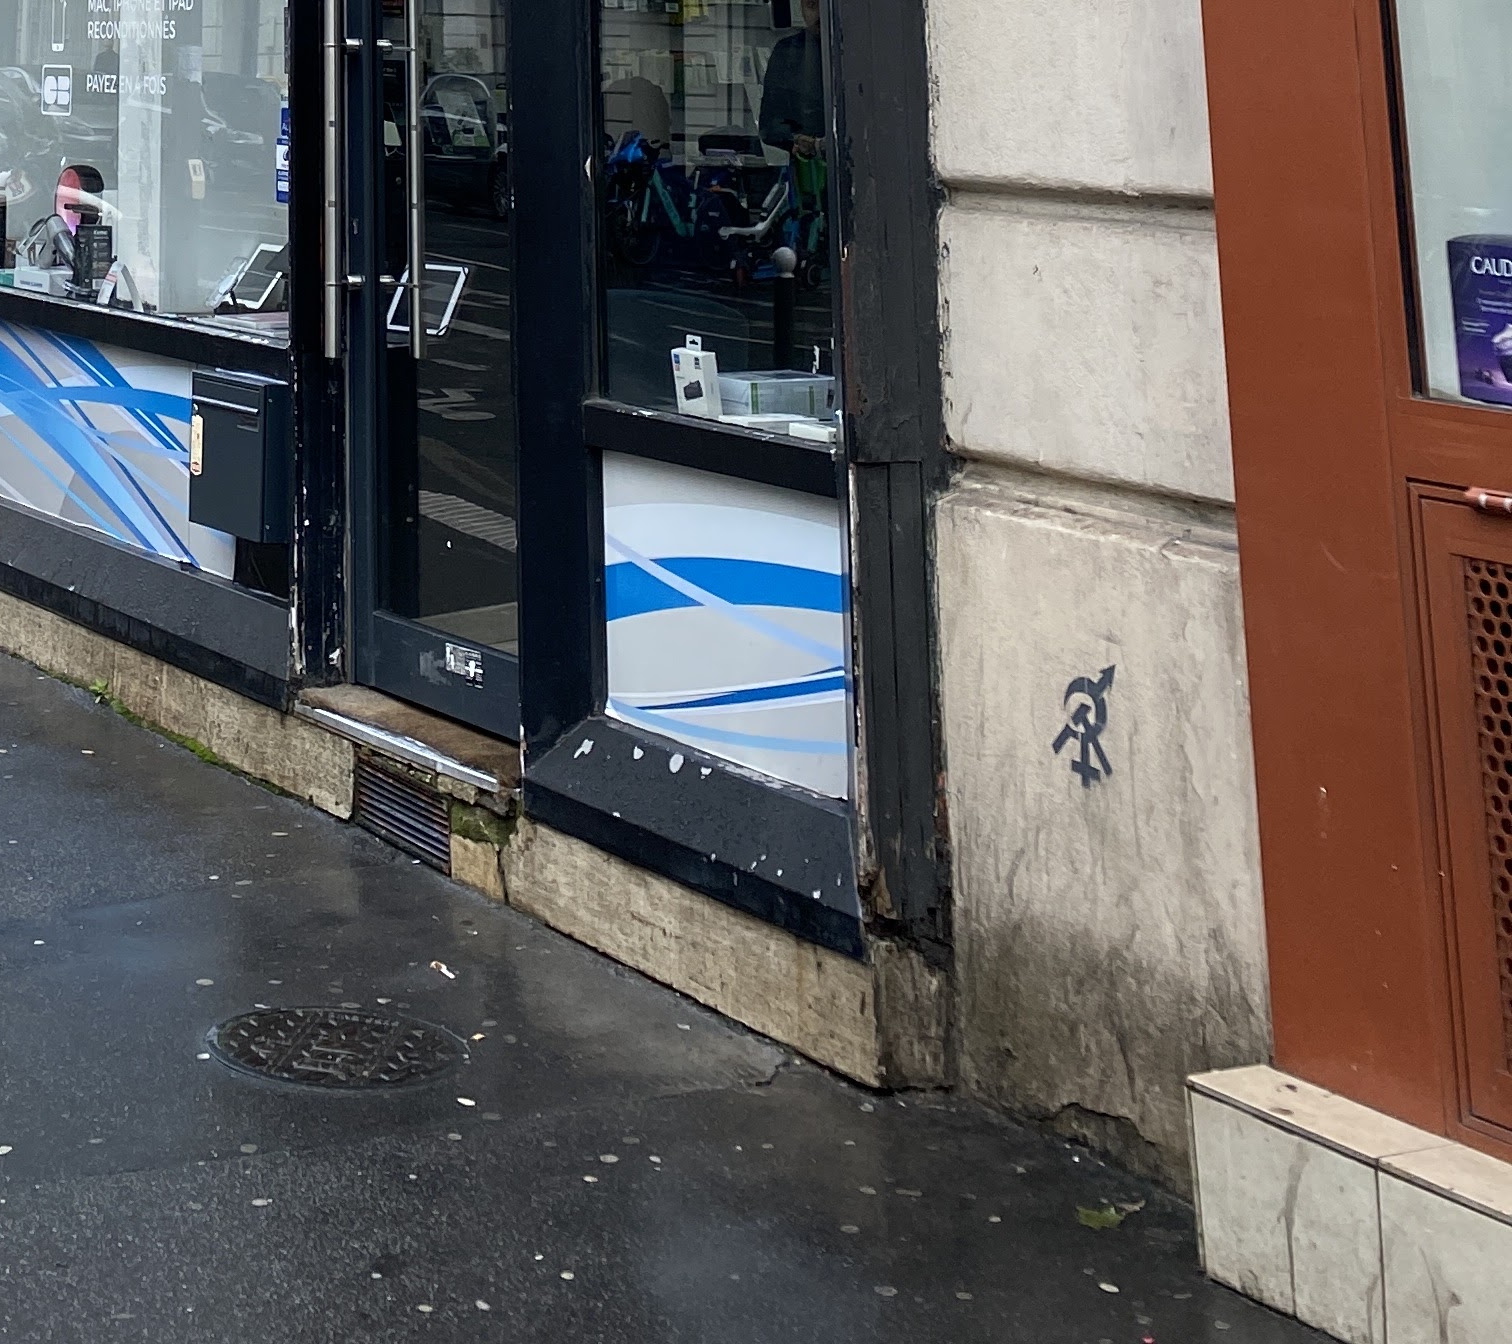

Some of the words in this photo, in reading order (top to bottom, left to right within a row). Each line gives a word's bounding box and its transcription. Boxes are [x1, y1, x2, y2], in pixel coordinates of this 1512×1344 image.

[88, 15, 176, 40] RECONDITIONNÉS
[86, 74, 117, 94] PAYEZ
[119, 76, 133, 94] EN
[144, 76, 167, 95] FOIS
